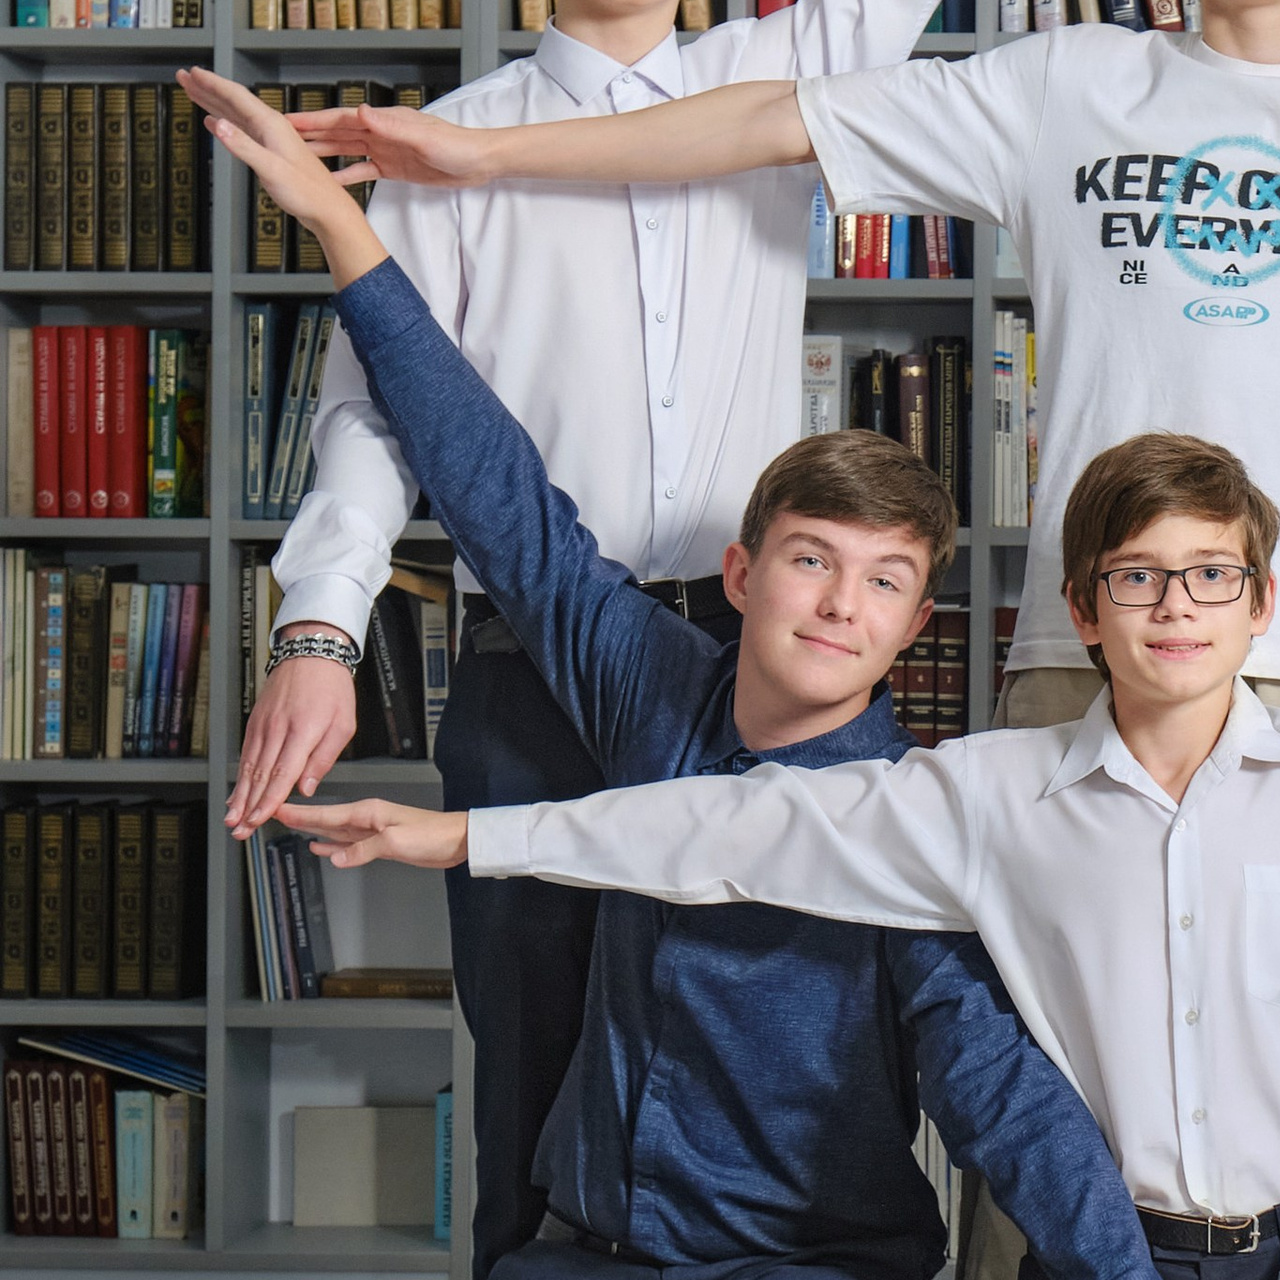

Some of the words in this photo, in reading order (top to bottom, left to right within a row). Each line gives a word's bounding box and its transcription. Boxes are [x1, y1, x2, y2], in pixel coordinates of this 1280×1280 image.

[1075, 154, 1221, 205] KEEP
[1122, 260, 1146, 272] NI
[1222, 263, 1241, 274] A
[1119, 273, 1148, 285] CE
[1212, 275, 1249, 287] ND
